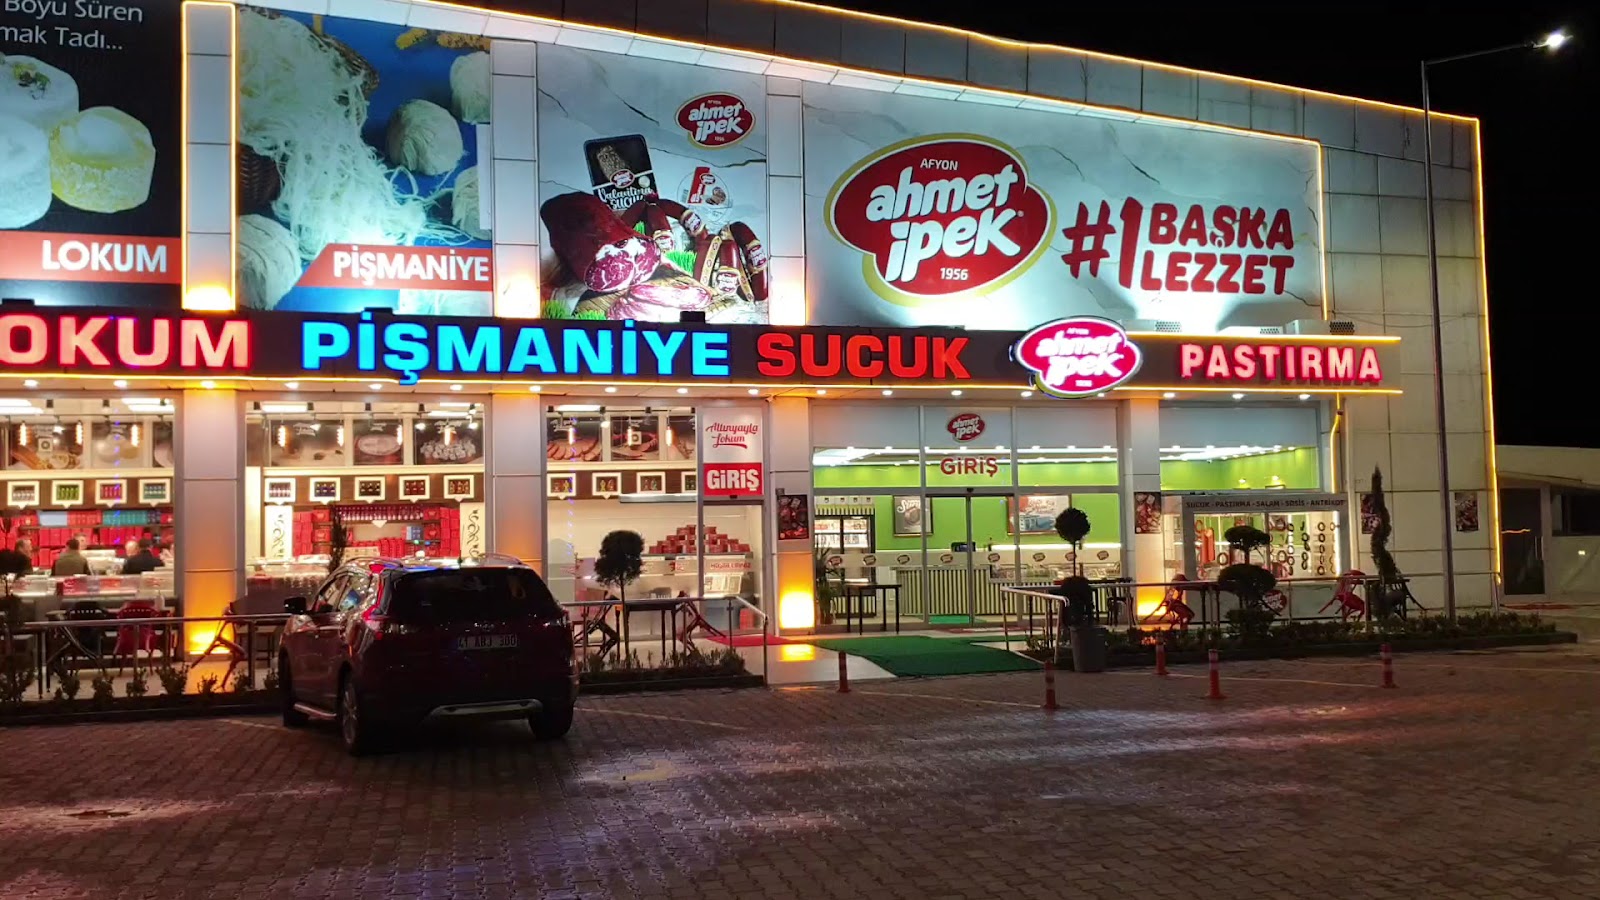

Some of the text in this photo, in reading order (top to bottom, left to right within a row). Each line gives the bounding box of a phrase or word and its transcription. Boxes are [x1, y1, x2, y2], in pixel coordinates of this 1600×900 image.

[4, 0, 143, 22] Boyu Süren
[688, 102, 743, 121] ahmet
[695, 117, 744, 142] ipek
[920, 158, 959, 171] AFYON
[866, 164, 1018, 222] ahmet
[885, 207, 1021, 283] ipek
[1061, 196, 1144, 289] #1
[1149, 202, 1294, 251] BAŞKA
[41, 239, 168, 273] LOKUM
[332, 245, 490, 287] PİŞMANİYE
[940, 267, 969, 281] 1956
[1140, 250, 1295, 295] LEZZET
[302, 311, 731, 386] PİŞMANİYE
[757, 332, 972, 380] SUCUK
[1179, 343, 1383, 381] PASTIRMA
